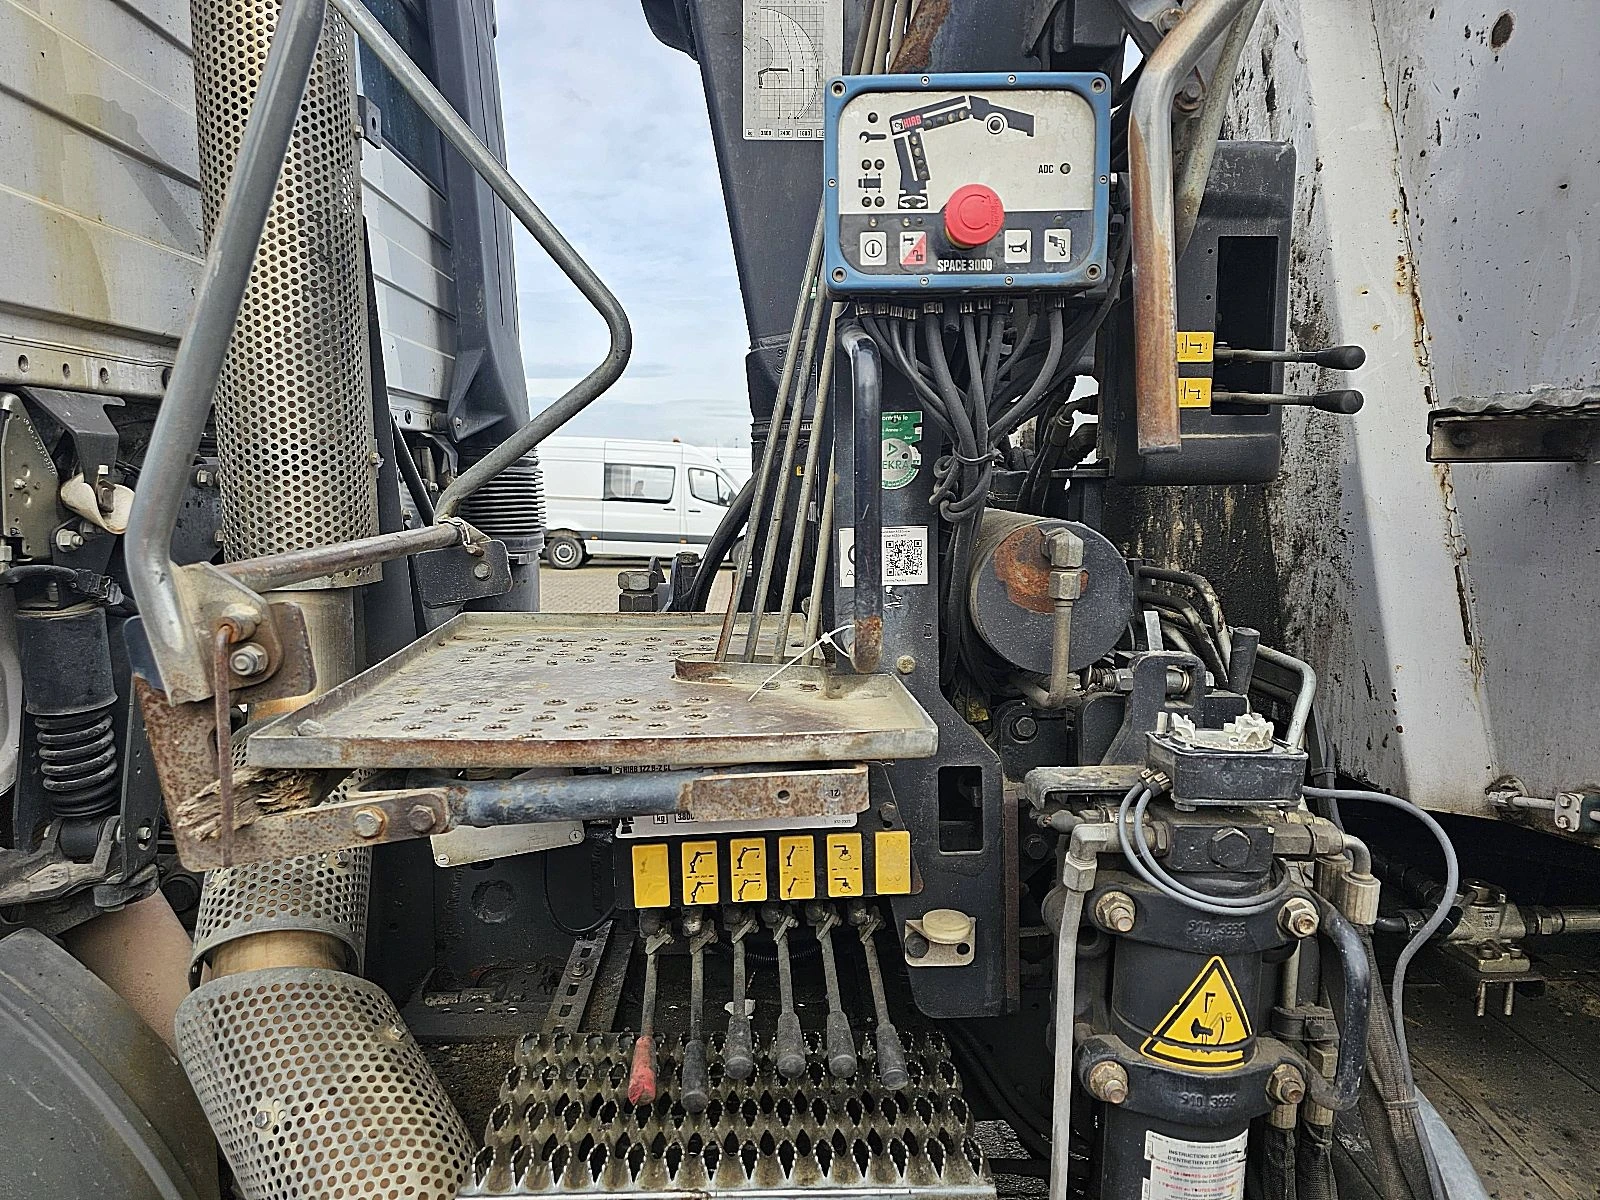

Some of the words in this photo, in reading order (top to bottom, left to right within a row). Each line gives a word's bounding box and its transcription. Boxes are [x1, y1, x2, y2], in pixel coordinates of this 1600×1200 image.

[903, 115, 922, 128] HIAB
[1038, 164, 1054, 174] ADC
[937, 259, 967, 272] SPACE
[968, 258, 993, 271] 3000
[882, 460, 909, 470] EKRA
[623, 765, 638, 774] HIAB
[656, 814, 665, 824] kg
[1168, 1148, 1210, 1160] INSTRUCTIONS
